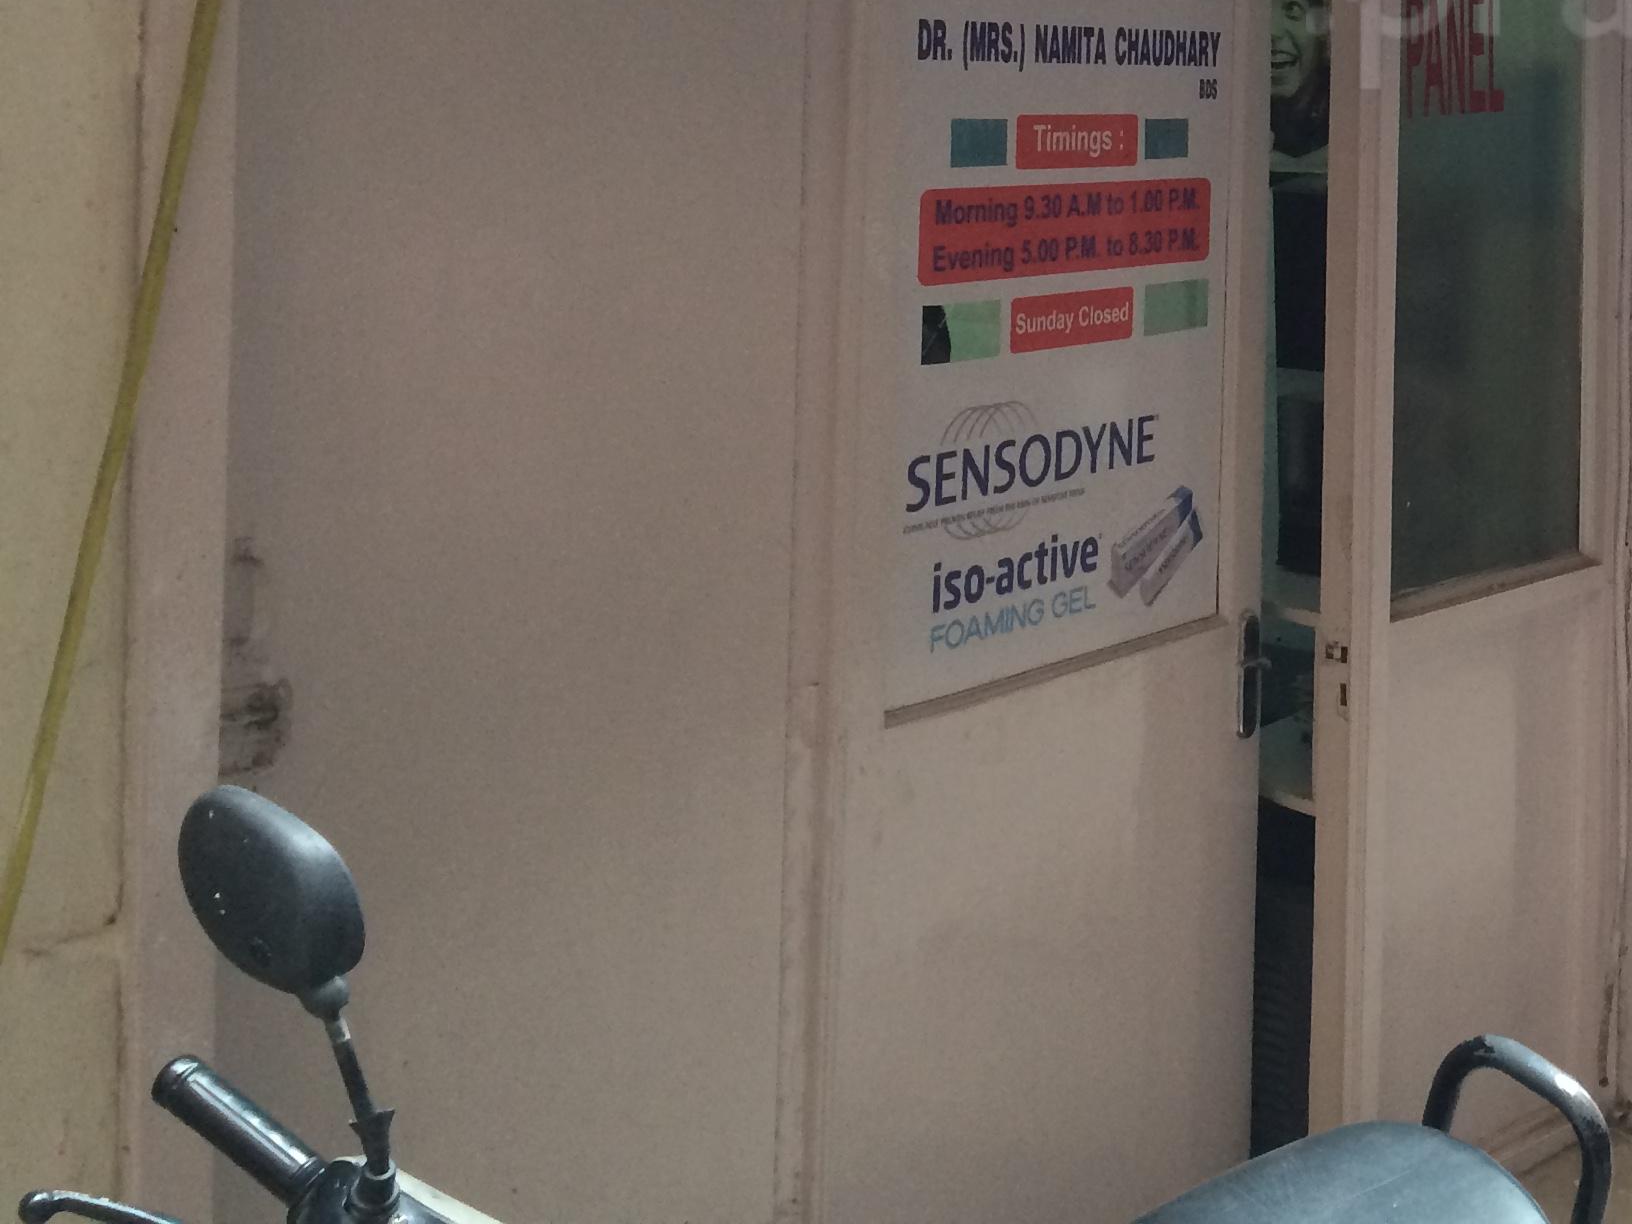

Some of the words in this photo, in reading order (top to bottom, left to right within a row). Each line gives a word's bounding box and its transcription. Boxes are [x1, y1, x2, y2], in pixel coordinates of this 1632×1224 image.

[917, 18, 952, 61] DR.
[962, 20, 1025, 72] (MRS.)
[1034, 24, 1107, 65] NAMITA
[1115, 27, 1221, 67] CHAUDHARY
[1199, 79, 1217, 100] BDS
[1033, 124, 1113, 158] Timings
[935, 197, 1018, 227] Morning
[1024, 194, 1062, 220] 9.30
[1107, 194, 1124, 214] to
[1129, 189, 1163, 214] 1.00
[933, 242, 1014, 272] Evening
[1021, 239, 1058, 264] 5.00
[1107, 235, 1124, 256] to
[1129, 230, 1162, 255] 8.30
[1015, 309, 1073, 336] Sunday
[1078, 302, 1129, 327] Closed
[906, 415, 1157, 513] SENSODYNE
[932, 534, 1099, 614] iso-active
[929, 598, 1045, 653] FOAMING
[1051, 586, 1097, 619] GEL
